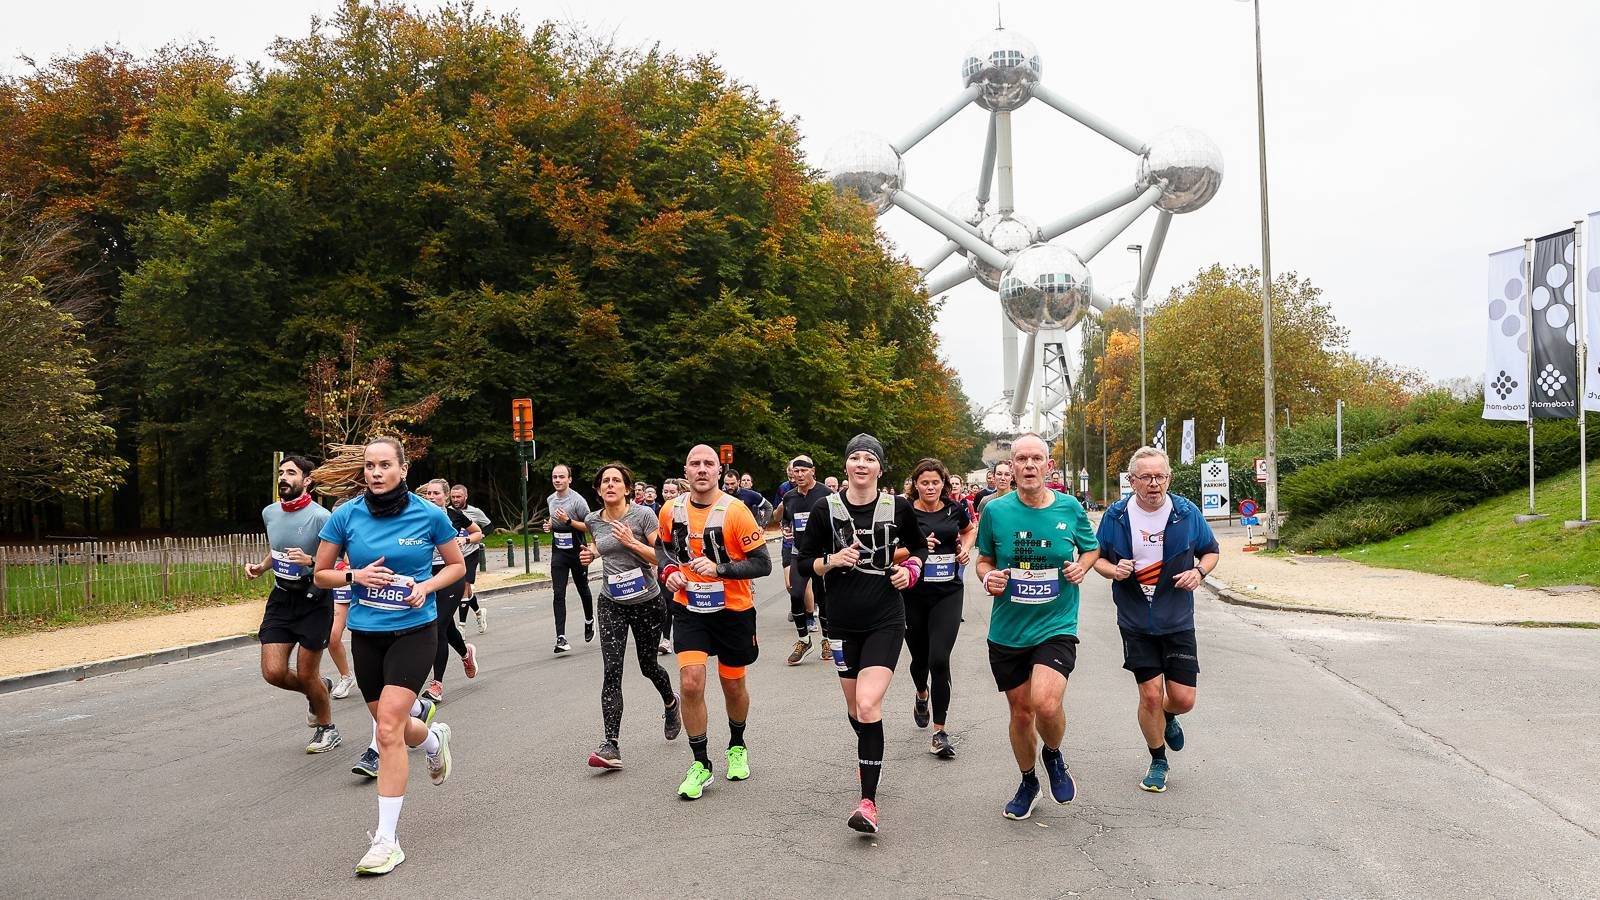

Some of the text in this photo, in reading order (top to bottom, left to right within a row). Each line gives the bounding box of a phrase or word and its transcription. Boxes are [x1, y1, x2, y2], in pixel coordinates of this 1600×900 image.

[616, 580, 636, 589] Christine
[1016, 584, 1052, 595] 12525
[366, 587, 404, 602] 13486
